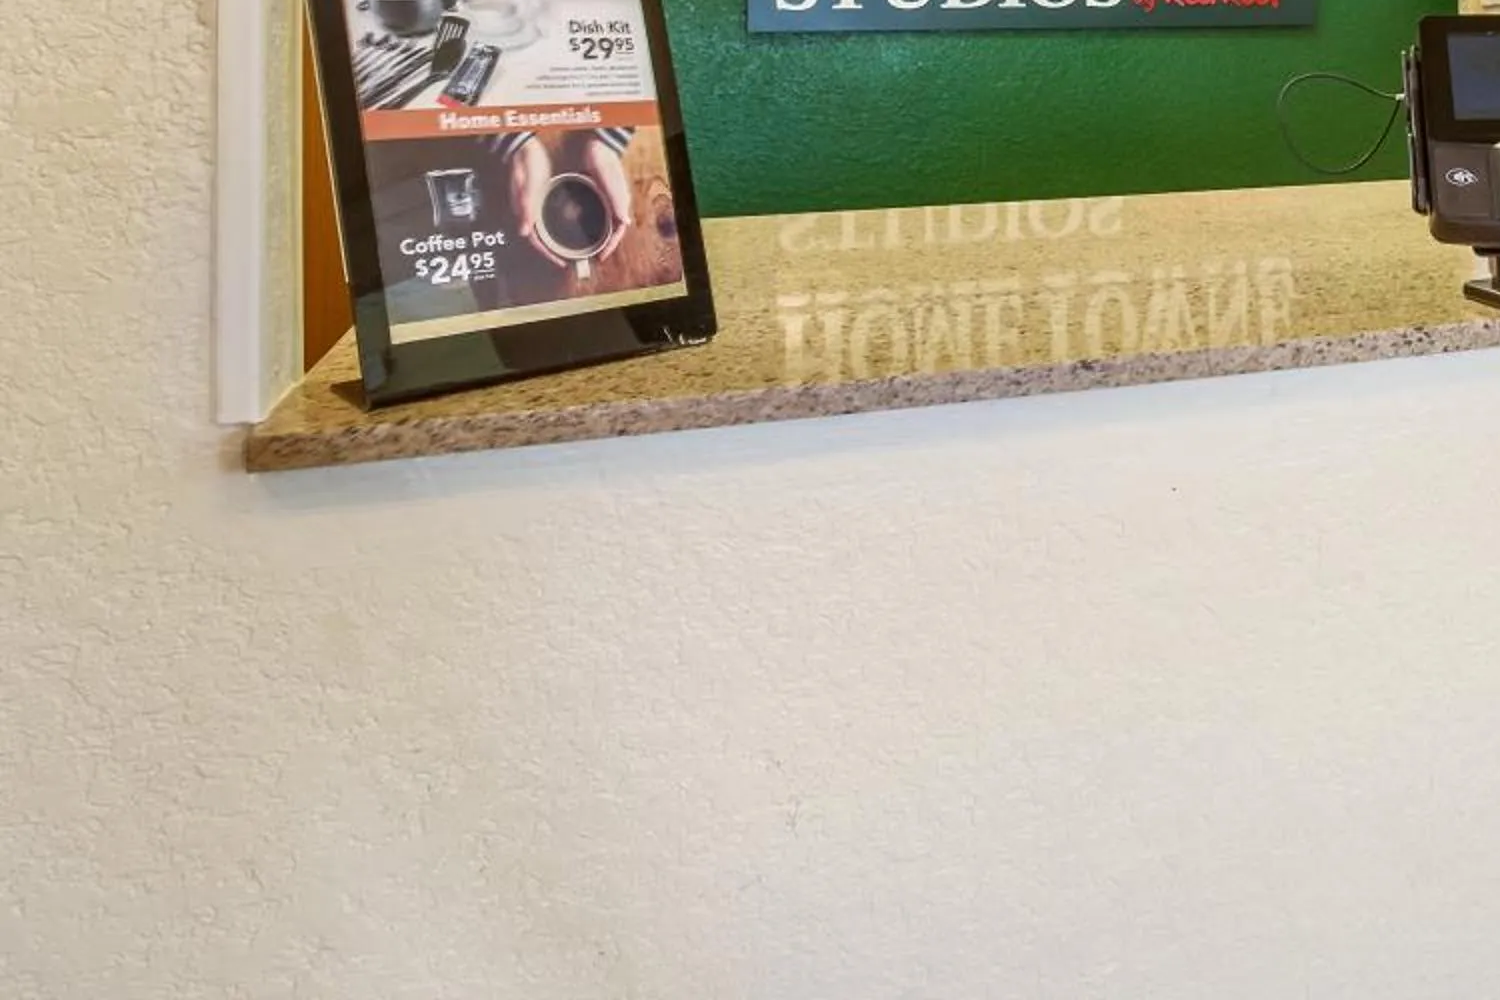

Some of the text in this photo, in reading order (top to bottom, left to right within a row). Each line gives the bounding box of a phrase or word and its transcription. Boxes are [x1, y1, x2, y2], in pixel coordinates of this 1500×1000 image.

[568, 19, 632, 35] Dish Kit
[439, 105, 601, 131] Home Essentials
[400, 230, 505, 255] Coffee Pot
